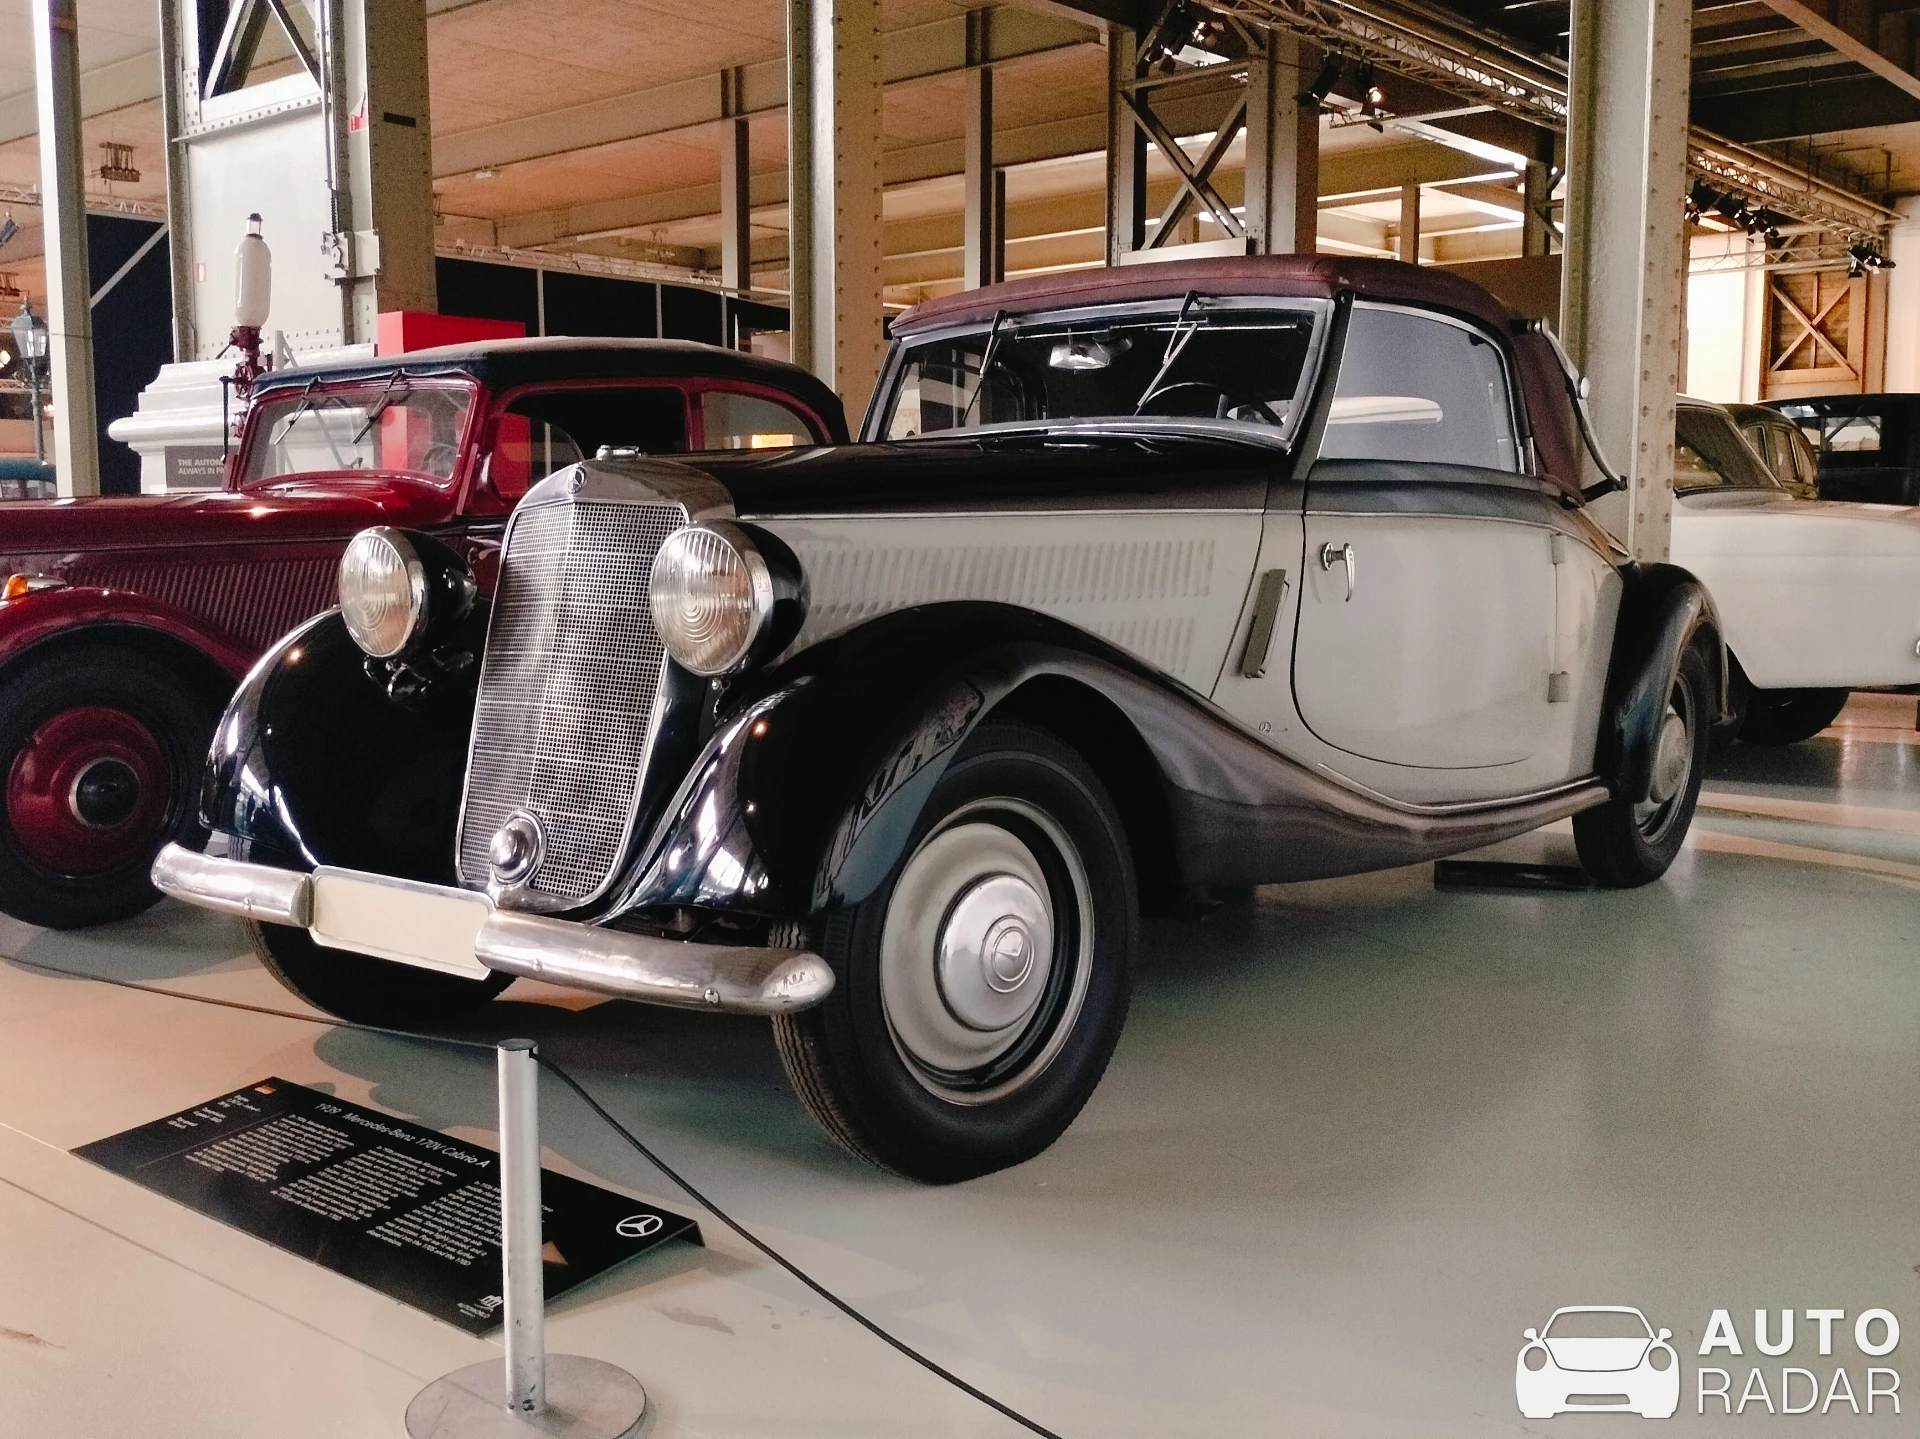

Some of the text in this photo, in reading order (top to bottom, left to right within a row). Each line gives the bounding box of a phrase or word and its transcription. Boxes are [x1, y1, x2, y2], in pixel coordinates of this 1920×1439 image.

[316, 1103, 342, 1113] 1939
[343, 1113, 415, 1141] Mercedes-Benz
[416, 1138, 446, 1150] 170V
[442, 1148, 477, 1163] Cabrio
